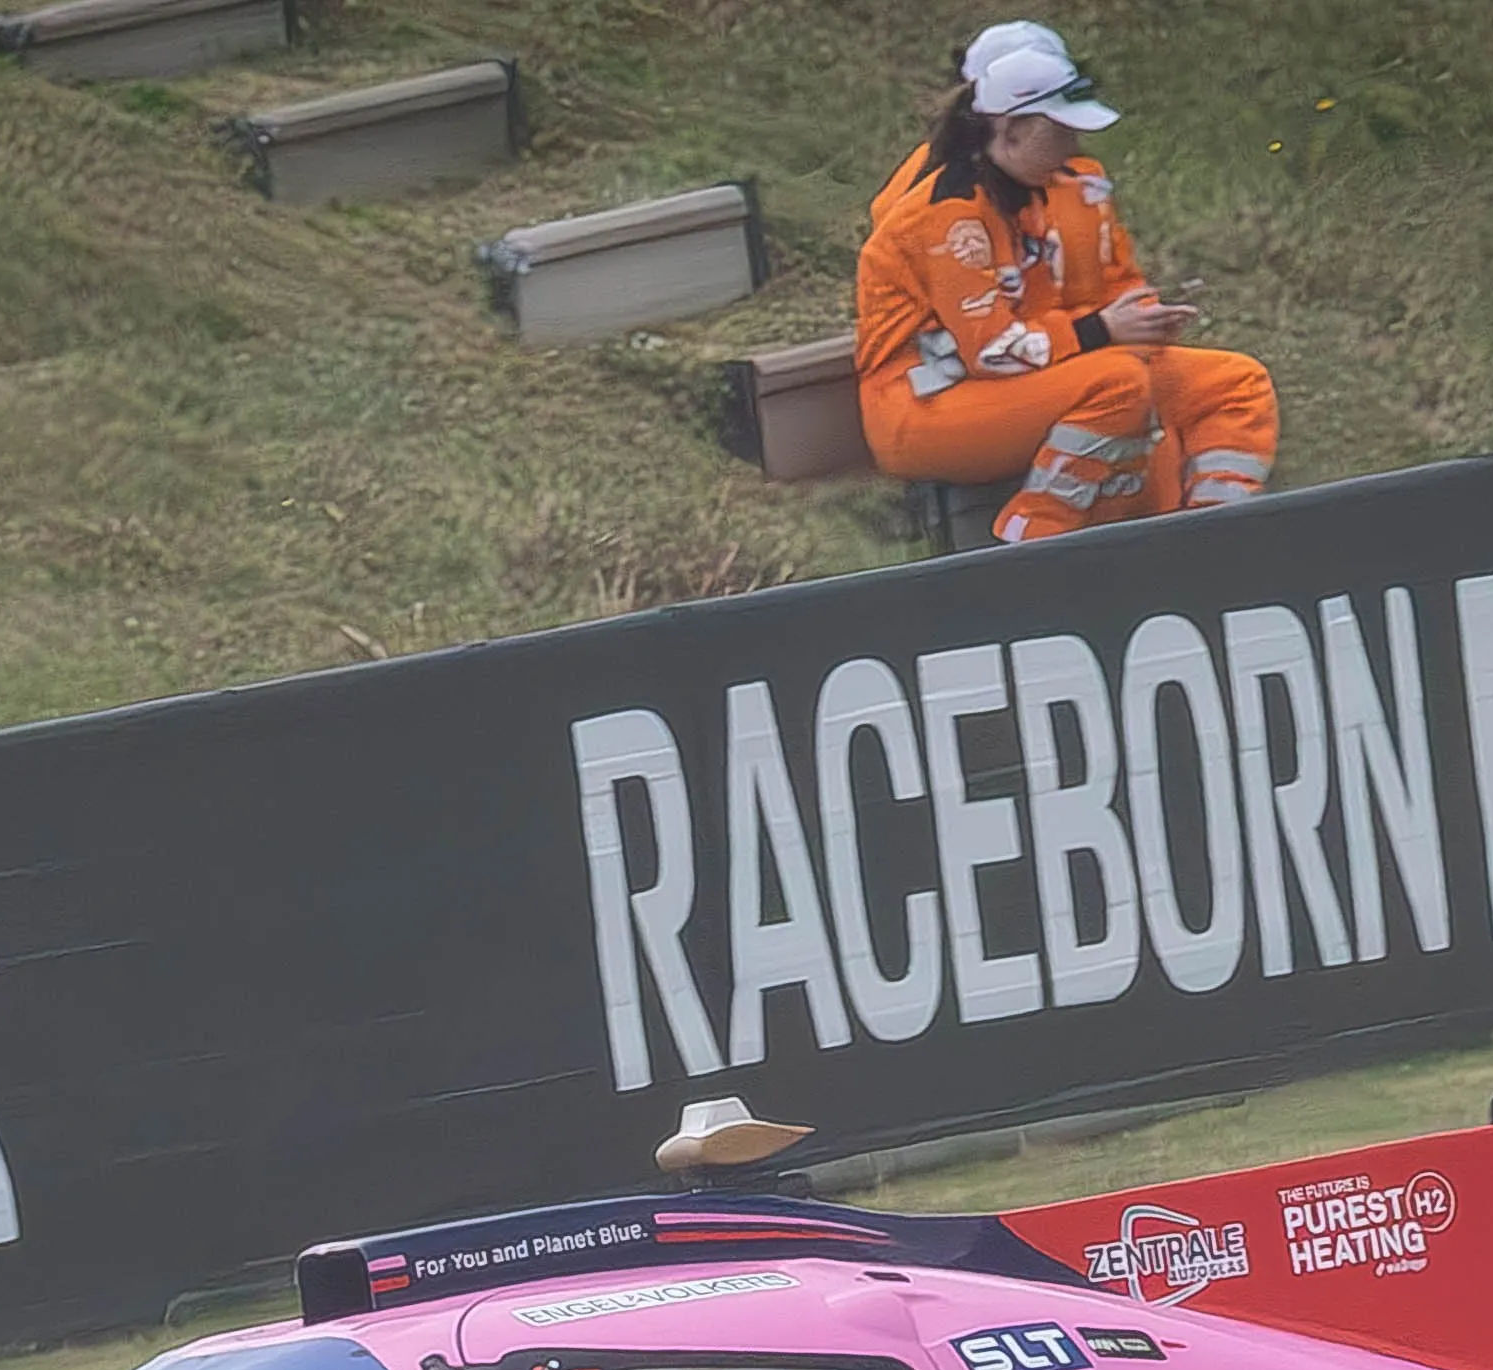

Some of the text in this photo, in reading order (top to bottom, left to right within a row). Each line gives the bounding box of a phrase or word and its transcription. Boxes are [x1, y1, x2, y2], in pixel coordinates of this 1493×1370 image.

[571, 587, 1451, 1092] RACEBORN
[1278, 1190, 1305, 1204] THE
[1356, 1176, 1370, 1189] IS
[1283, 1187, 1448, 1239] PUREST H2
[415, 1222, 649, 1279] For You and Planet Blue.
[1085, 1225, 1246, 1281] ZENTRALE
[1289, 1221, 1427, 1274] HEATING
